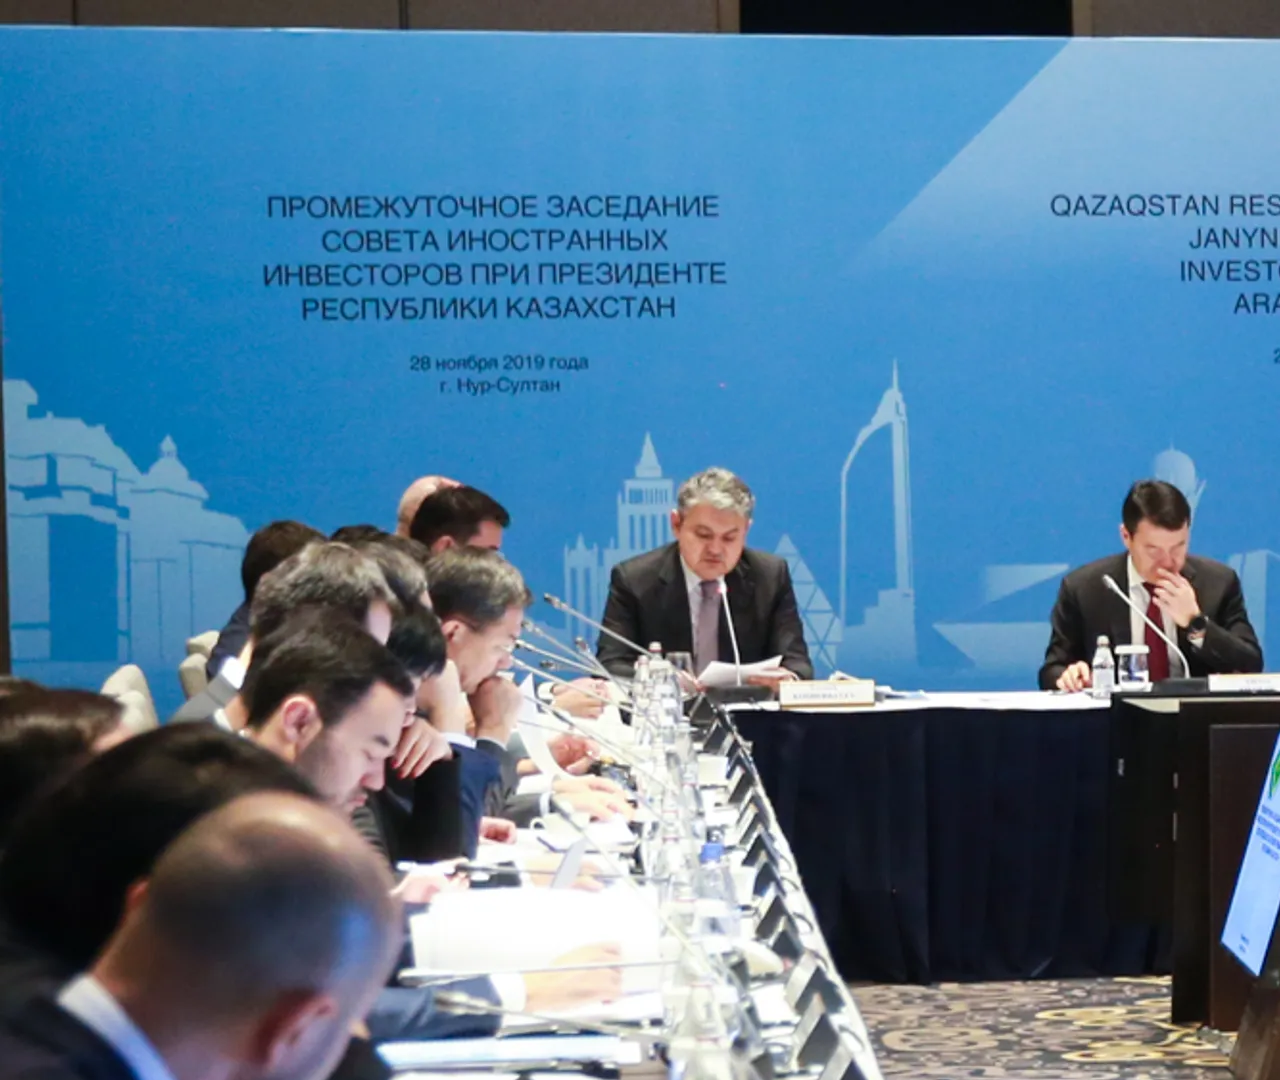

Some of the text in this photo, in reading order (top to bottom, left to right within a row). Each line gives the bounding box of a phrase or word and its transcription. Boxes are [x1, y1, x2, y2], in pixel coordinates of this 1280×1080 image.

[268, 195, 719, 221] ПРОМЕЖУТОЧНОЕ ЗАСЕДАНИЕ
[1051, 194, 1219, 217] QAZAQSTAN
[322, 229, 668, 252] СОВЕТА ИНОСТРАННЫХ
[264, 262, 727, 288] ИНВЕСТОРОВ ПРИ ПРЕЗИДЕНТЕ
[302, 296, 675, 321] РЕСПУБЛИКИ КАЗАХСТАН
[410, 355, 589, 375] 28 ноября 2019 года
[457, 378, 561, 396] Нур-Султан
